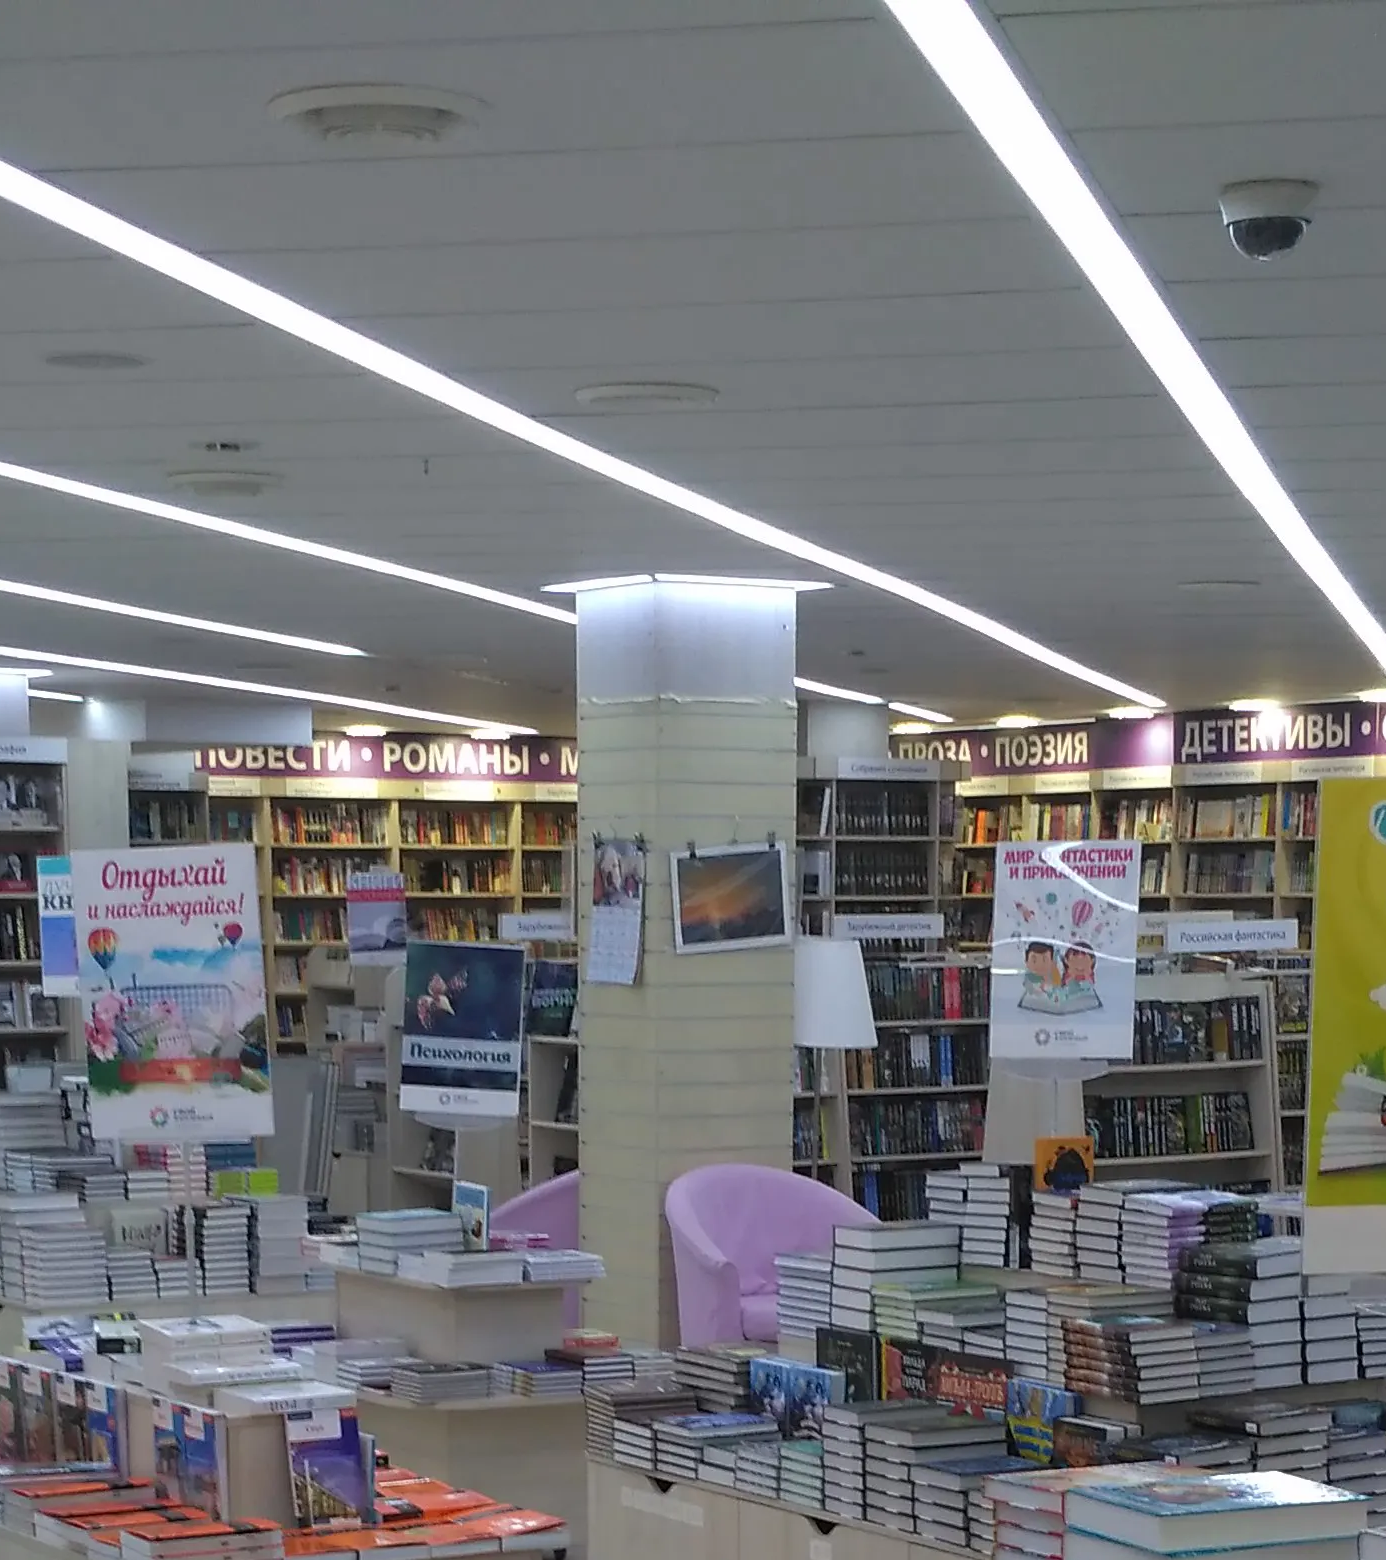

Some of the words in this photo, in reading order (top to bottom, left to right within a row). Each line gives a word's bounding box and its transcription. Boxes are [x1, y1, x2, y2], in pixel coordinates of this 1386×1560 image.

[383, 741, 530, 776] РОМАНЫ
[994, 731, 1089, 769] ПОЭЗИЯ
[1004, 851, 1035, 864] МИР
[1038, 848, 1134, 865] ФНТАСТИКИ
[101, 857, 228, 901] Отдыхай
[1009, 866, 1020, 880] И
[1023, 864, 1127, 880] ПРИКЮЧЕНИЙ
[87, 905, 100, 921] и
[104, 892, 245, 926] наслаждайся!
[1180, 931, 1233, 943] Российская
[1234, 929, 1286, 944] фантастика
[410, 1043, 512, 1064] Психология
